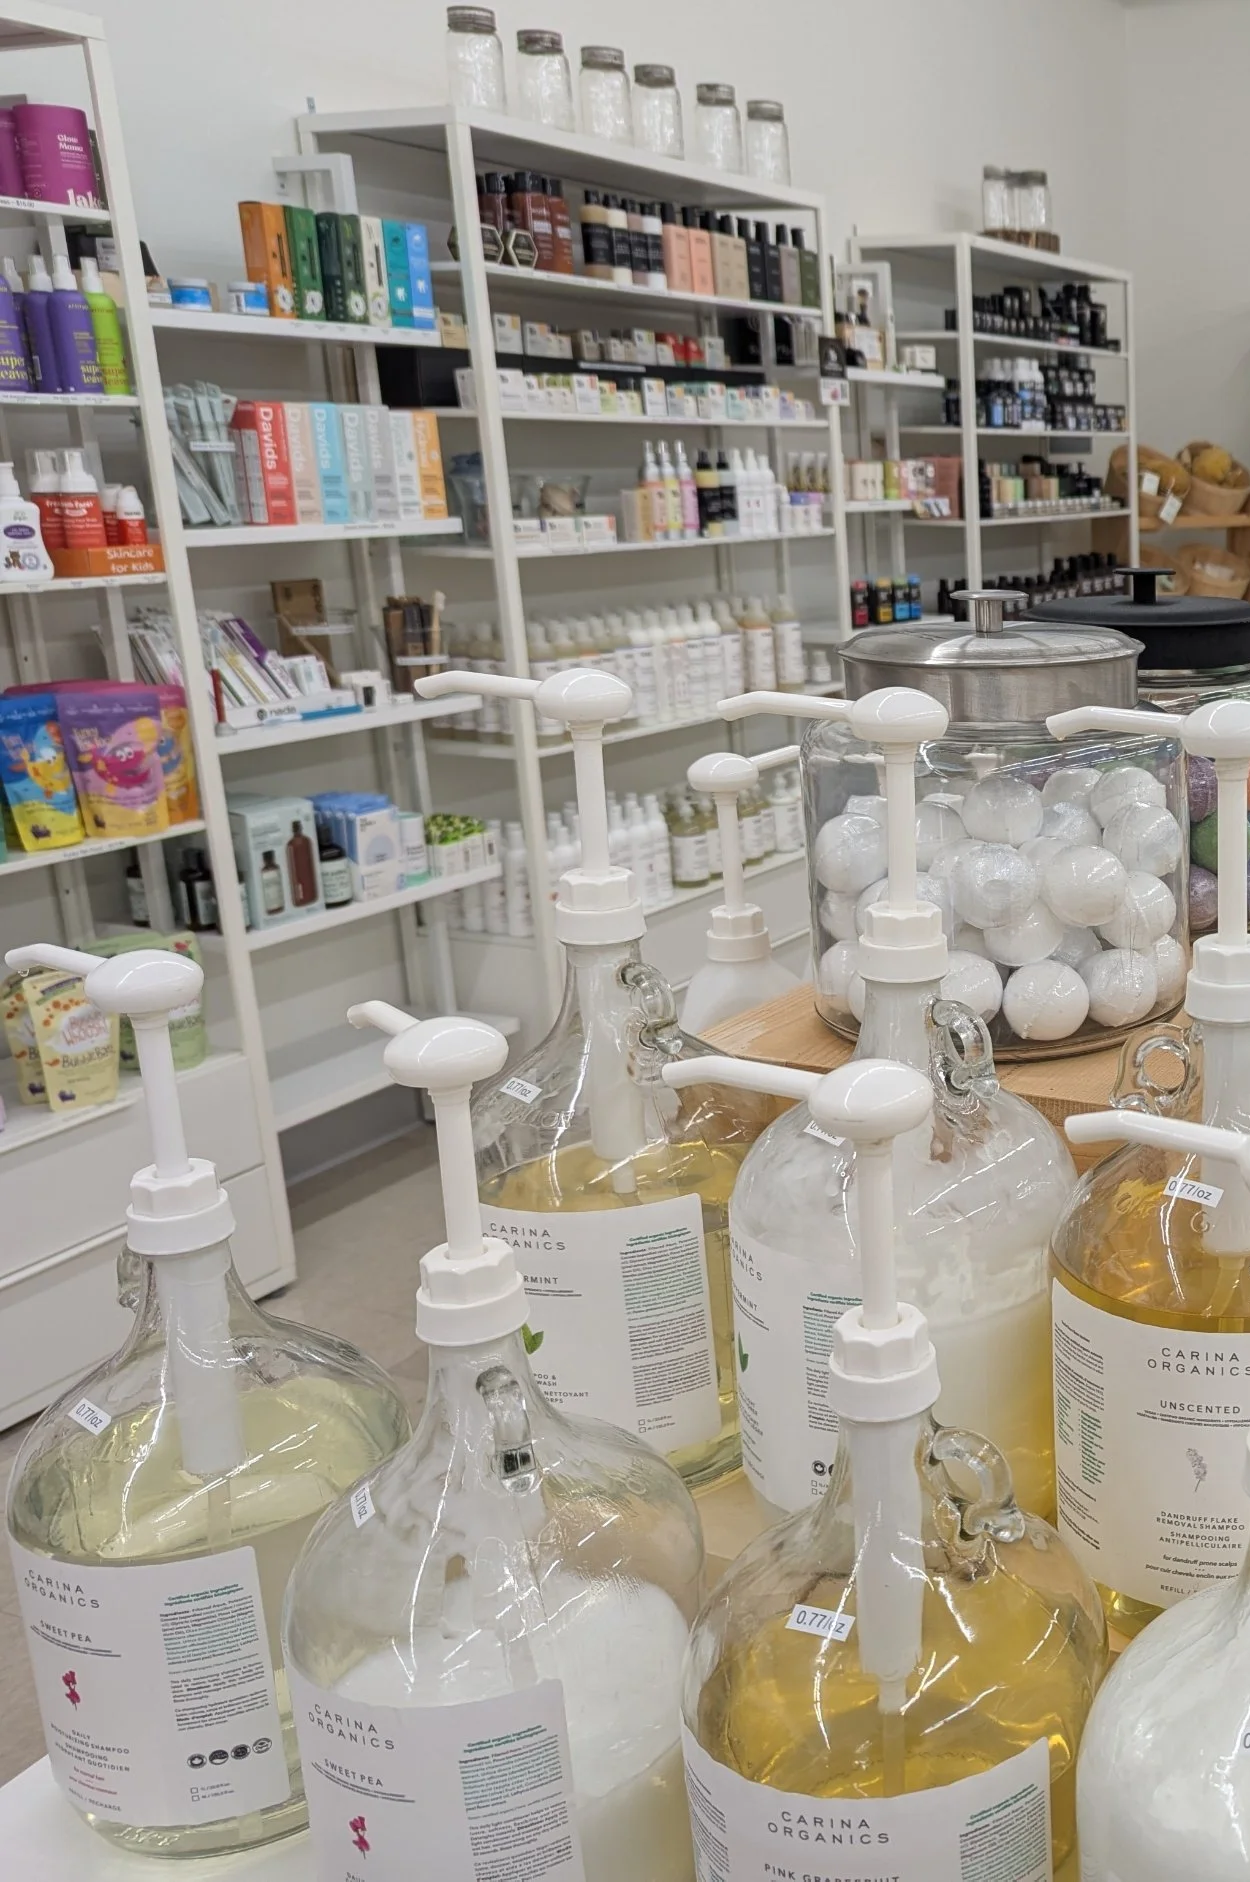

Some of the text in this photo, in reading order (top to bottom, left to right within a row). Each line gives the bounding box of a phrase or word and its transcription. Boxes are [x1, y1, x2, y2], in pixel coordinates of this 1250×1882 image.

[259, 406, 277, 471] Davids
[314, 408, 332, 470] Davids
[345, 412, 365, 483] Davids
[107, 547, 154, 560] Skincare
[111, 563, 128, 573] for
[506, 1080, 532, 1098] 0.77/oz
[490, 1222, 551, 1238] CARINA
[523, 1275, 558, 1285] RMINT
[1161, 1347, 1240, 1362] CARINA
[1160, 1400, 1240, 1414] UNSCENTED
[75, 1404, 104, 1428] 0.77/oz
[1156, 1516, 1198, 1529] REMOVAL
[1160, 1510, 1208, 1522] DANDRUFF
[1159, 1536, 1242, 1548] ANTIPELLICULAIRE
[1170, 1531, 1230, 1542] SHAMPOOING
[1172, 1556, 1198, 1566] dandruff
[1218, 1560, 1238, 1568] scalps
[1172, 1569, 1195, 1578] chevelu
[28, 1570, 84, 1594] CARINA
[1160, 1584, 1184, 1594] REFILL
[24, 1577, 100, 1609] ORGANICS
[40, 1620, 68, 1638] SWEET
[71, 1632, 92, 1643] PEA
[314, 1704, 378, 1734] CARINA
[308, 1712, 394, 1750] ORGANICS
[90, 1743, 130, 1754] SHAMPOO
[87, 1759, 130, 1772] QUOTIDIEN
[324, 1758, 356, 1780] SWEET
[360, 1774, 384, 1788] PEA
[88, 1798, 122, 1812] RECHARGE
[781, 1811, 870, 1830] CARINA
[768, 1822, 890, 1844] ORGANICS
[764, 1863, 796, 1881] PINK
